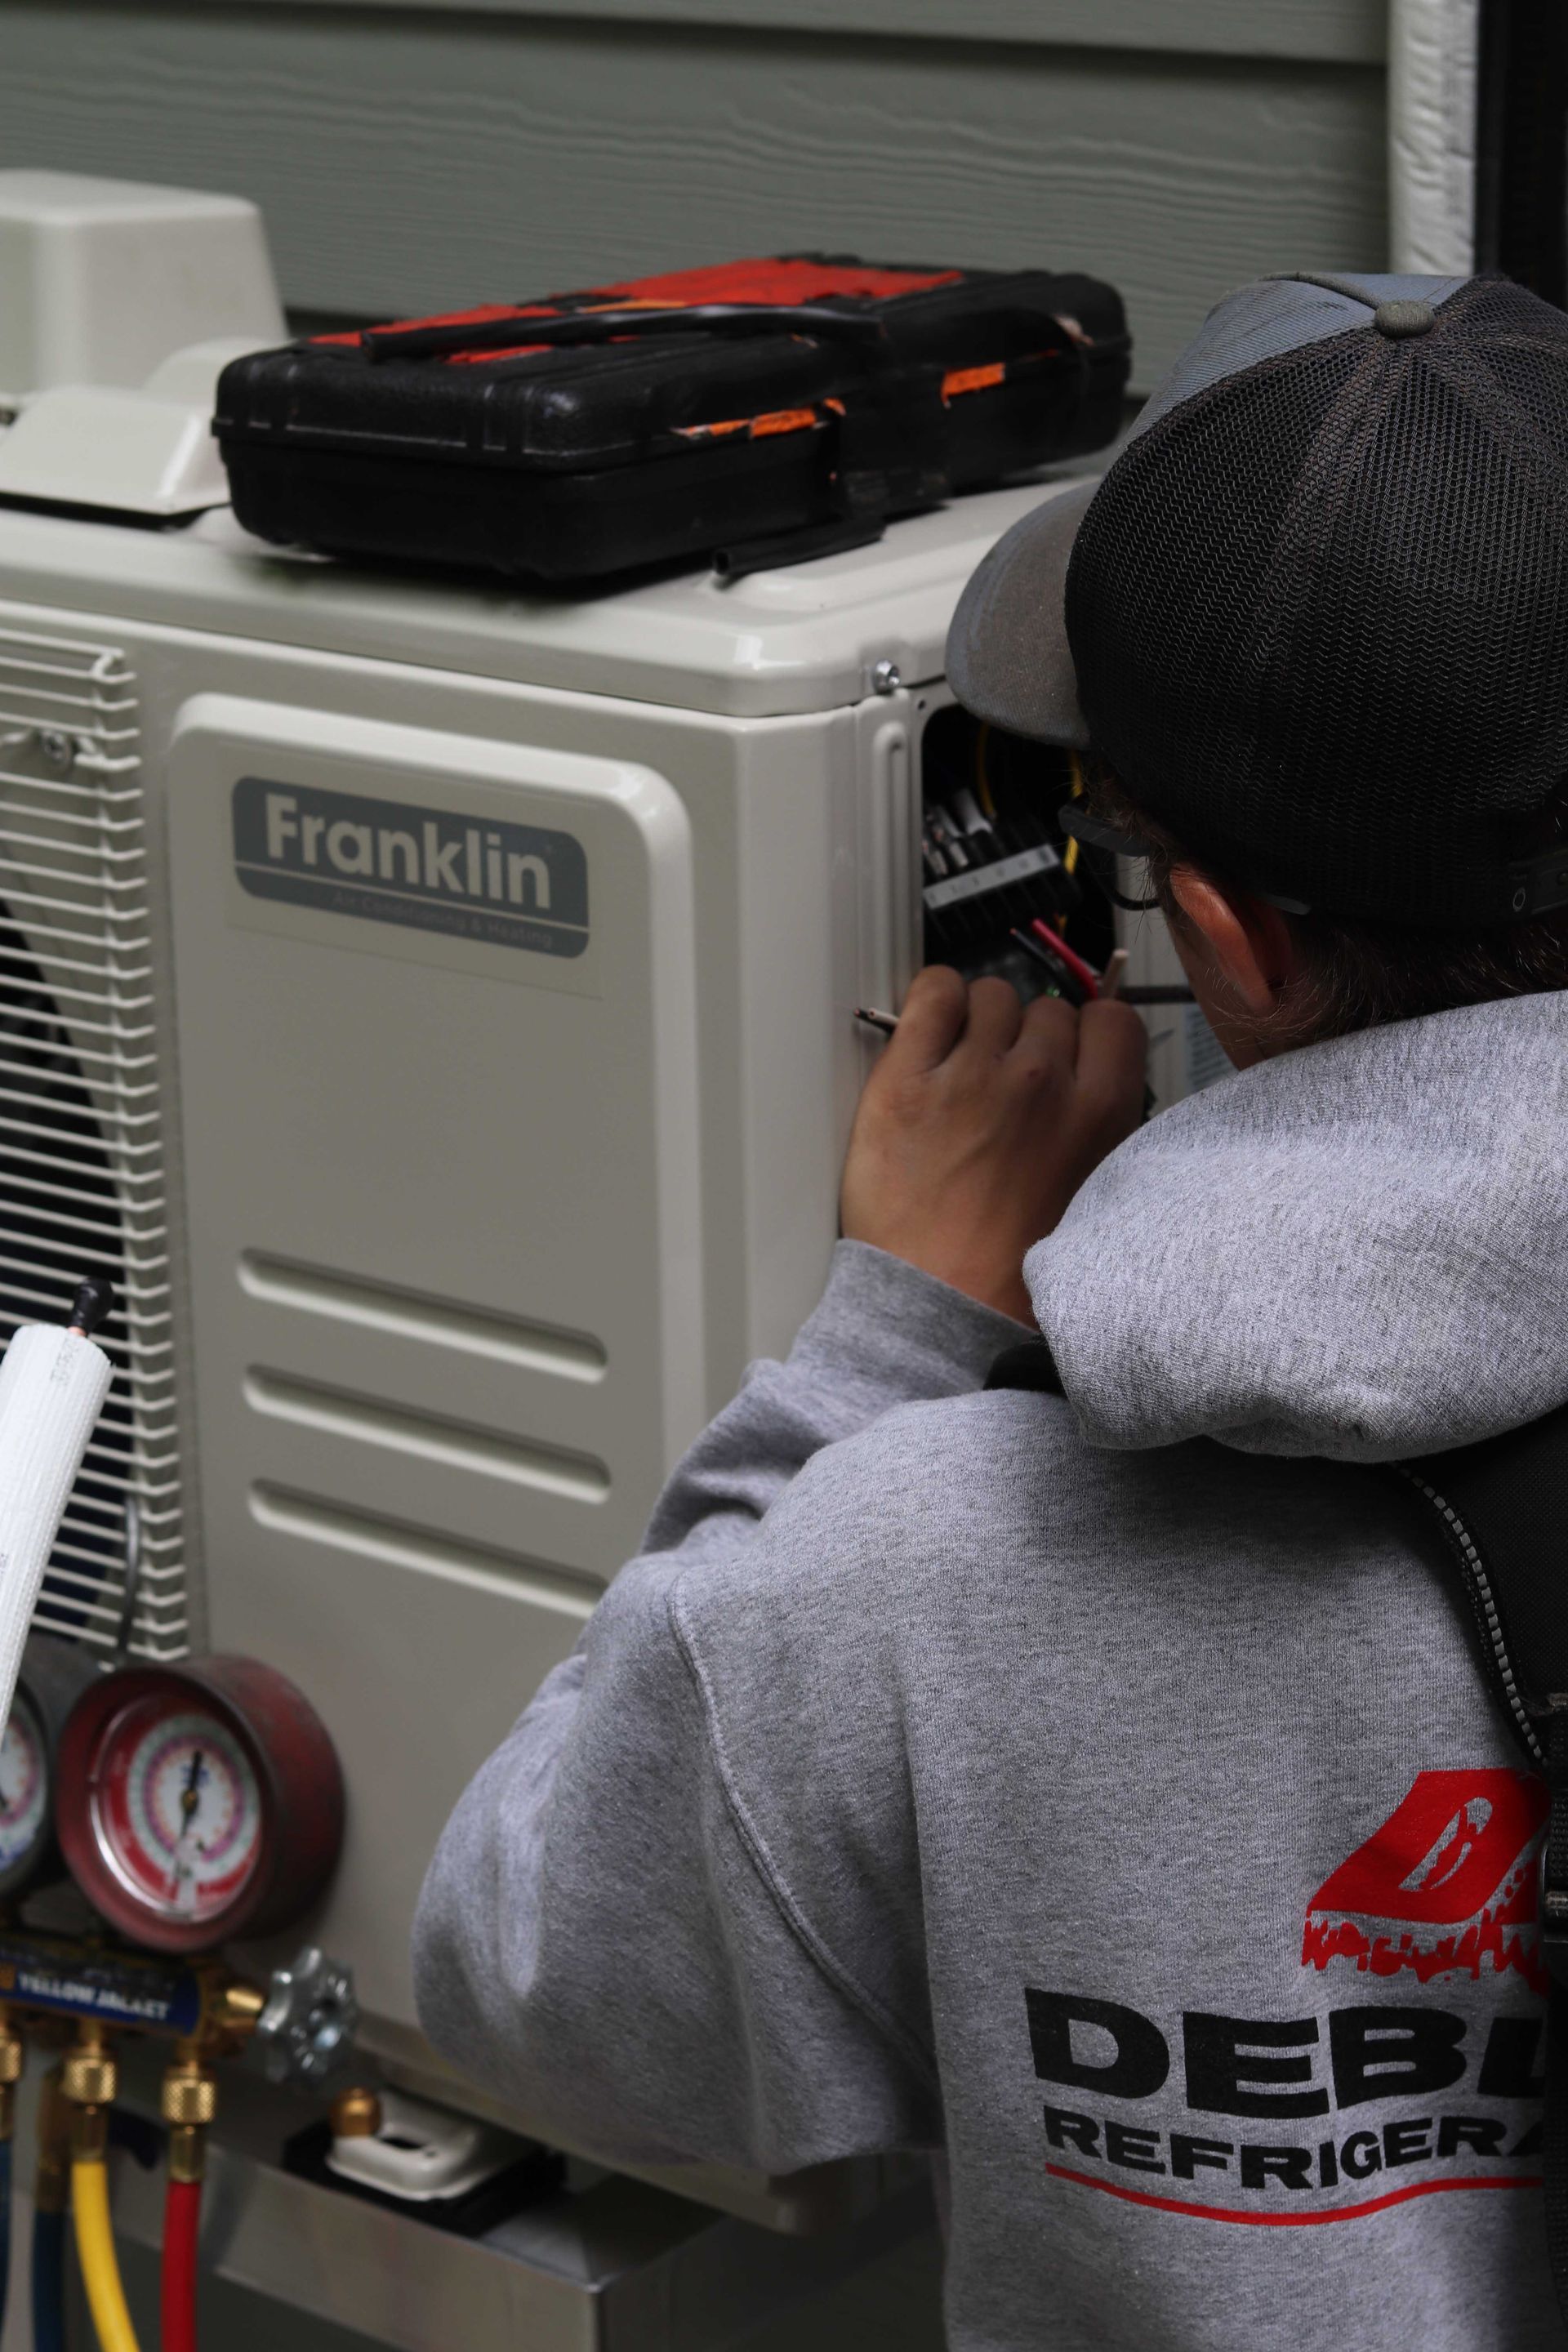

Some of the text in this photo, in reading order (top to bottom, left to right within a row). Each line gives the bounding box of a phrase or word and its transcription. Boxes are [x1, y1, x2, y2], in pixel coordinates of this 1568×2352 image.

[265, 794, 551, 909] Franklin
[488, 920, 553, 950] Heating
[18, 1971, 170, 2020] YELLOW JACKET
